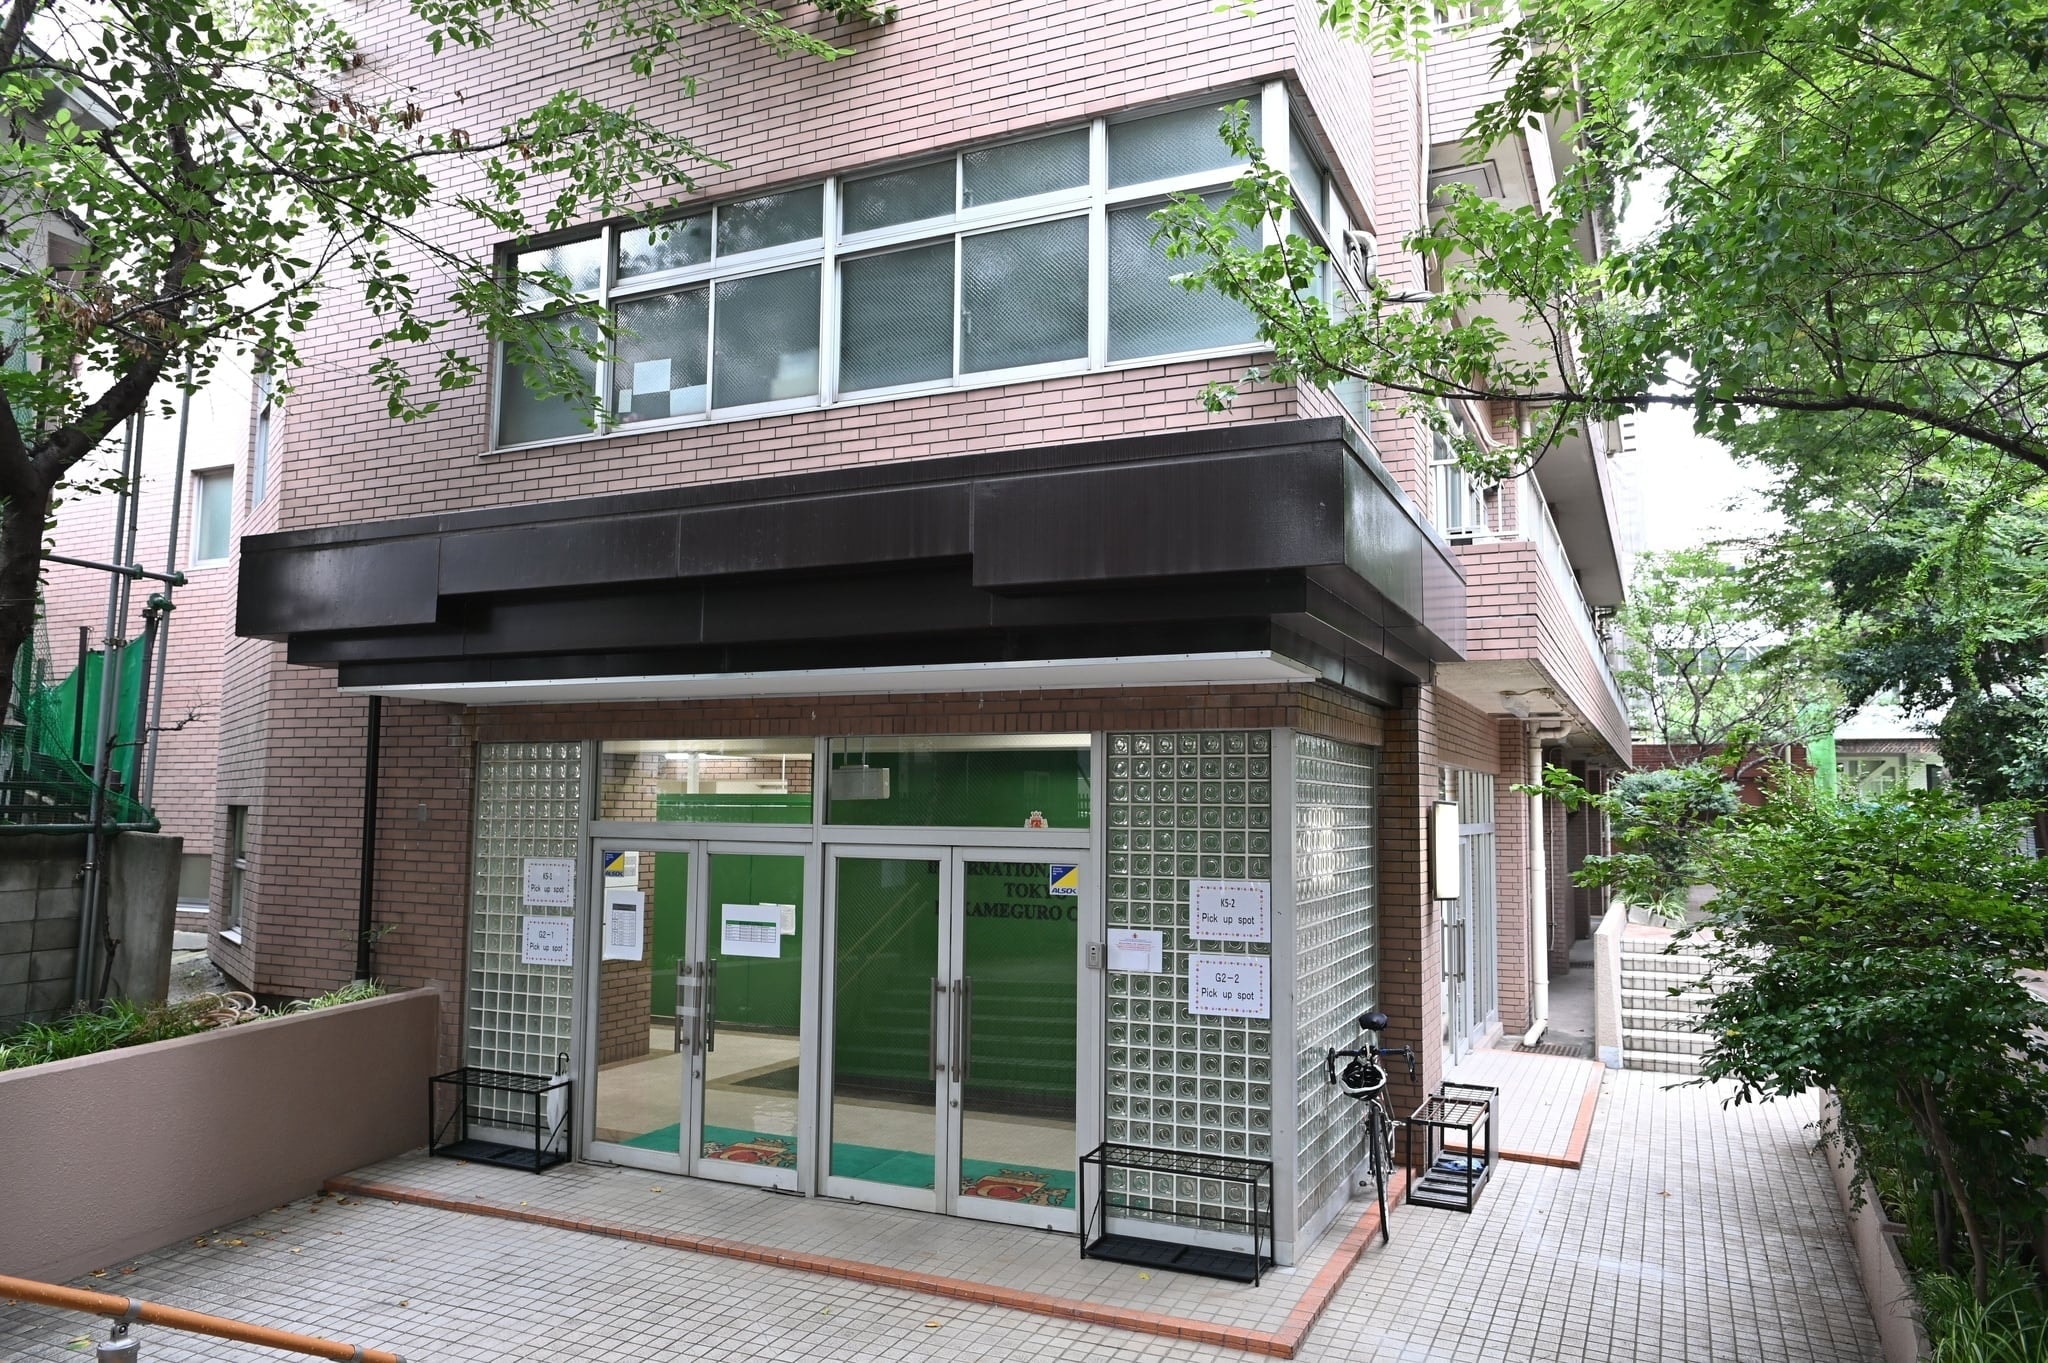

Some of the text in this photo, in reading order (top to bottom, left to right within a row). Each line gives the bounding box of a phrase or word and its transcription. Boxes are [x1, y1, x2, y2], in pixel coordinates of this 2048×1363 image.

[530, 883, 541, 892] Pick
[1220, 898, 1236, 908] K5-2
[1201, 912, 1255, 926] Pick up spot
[529, 942, 540, 950] Pick
[1215, 972, 1240, 984] G2-2
[1201, 987, 1255, 1001] Pick up spot
